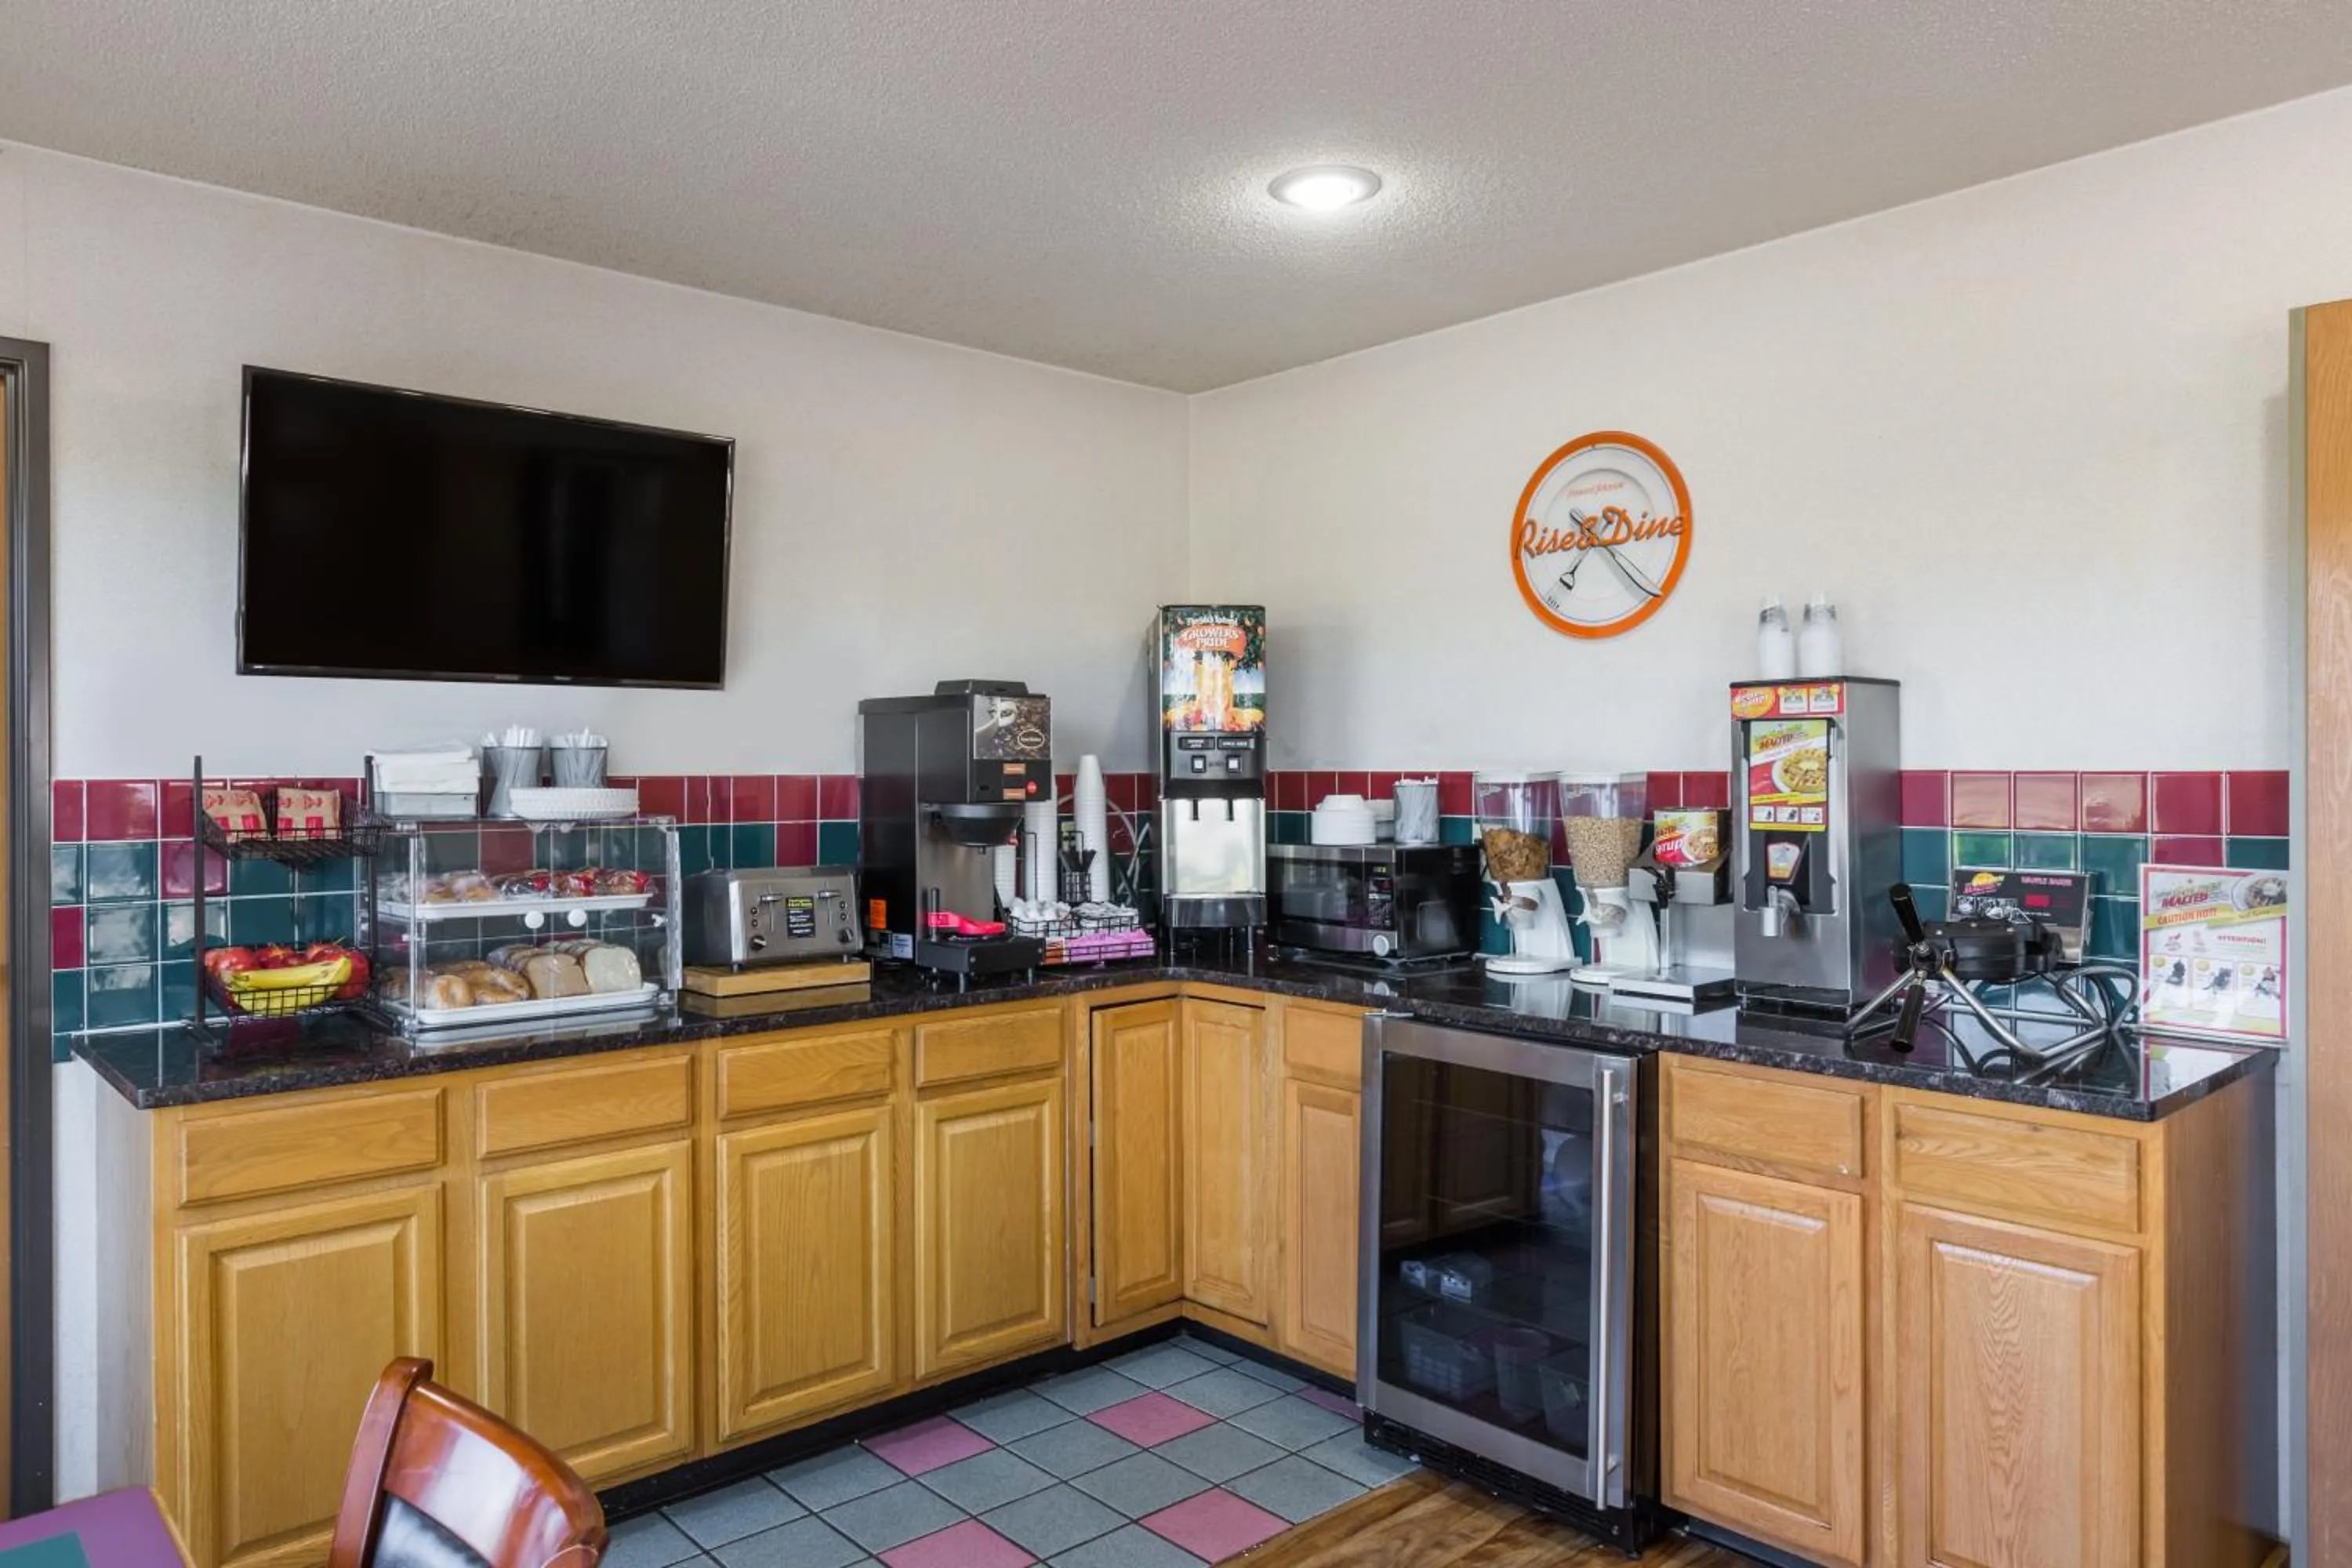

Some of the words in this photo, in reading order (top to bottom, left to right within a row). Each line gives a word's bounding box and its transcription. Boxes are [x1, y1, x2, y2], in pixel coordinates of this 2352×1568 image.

[1516, 519, 1575, 560] Rise
[1599, 506, 1685, 547] Dine
[2157, 911, 2194, 925] CAUTION
